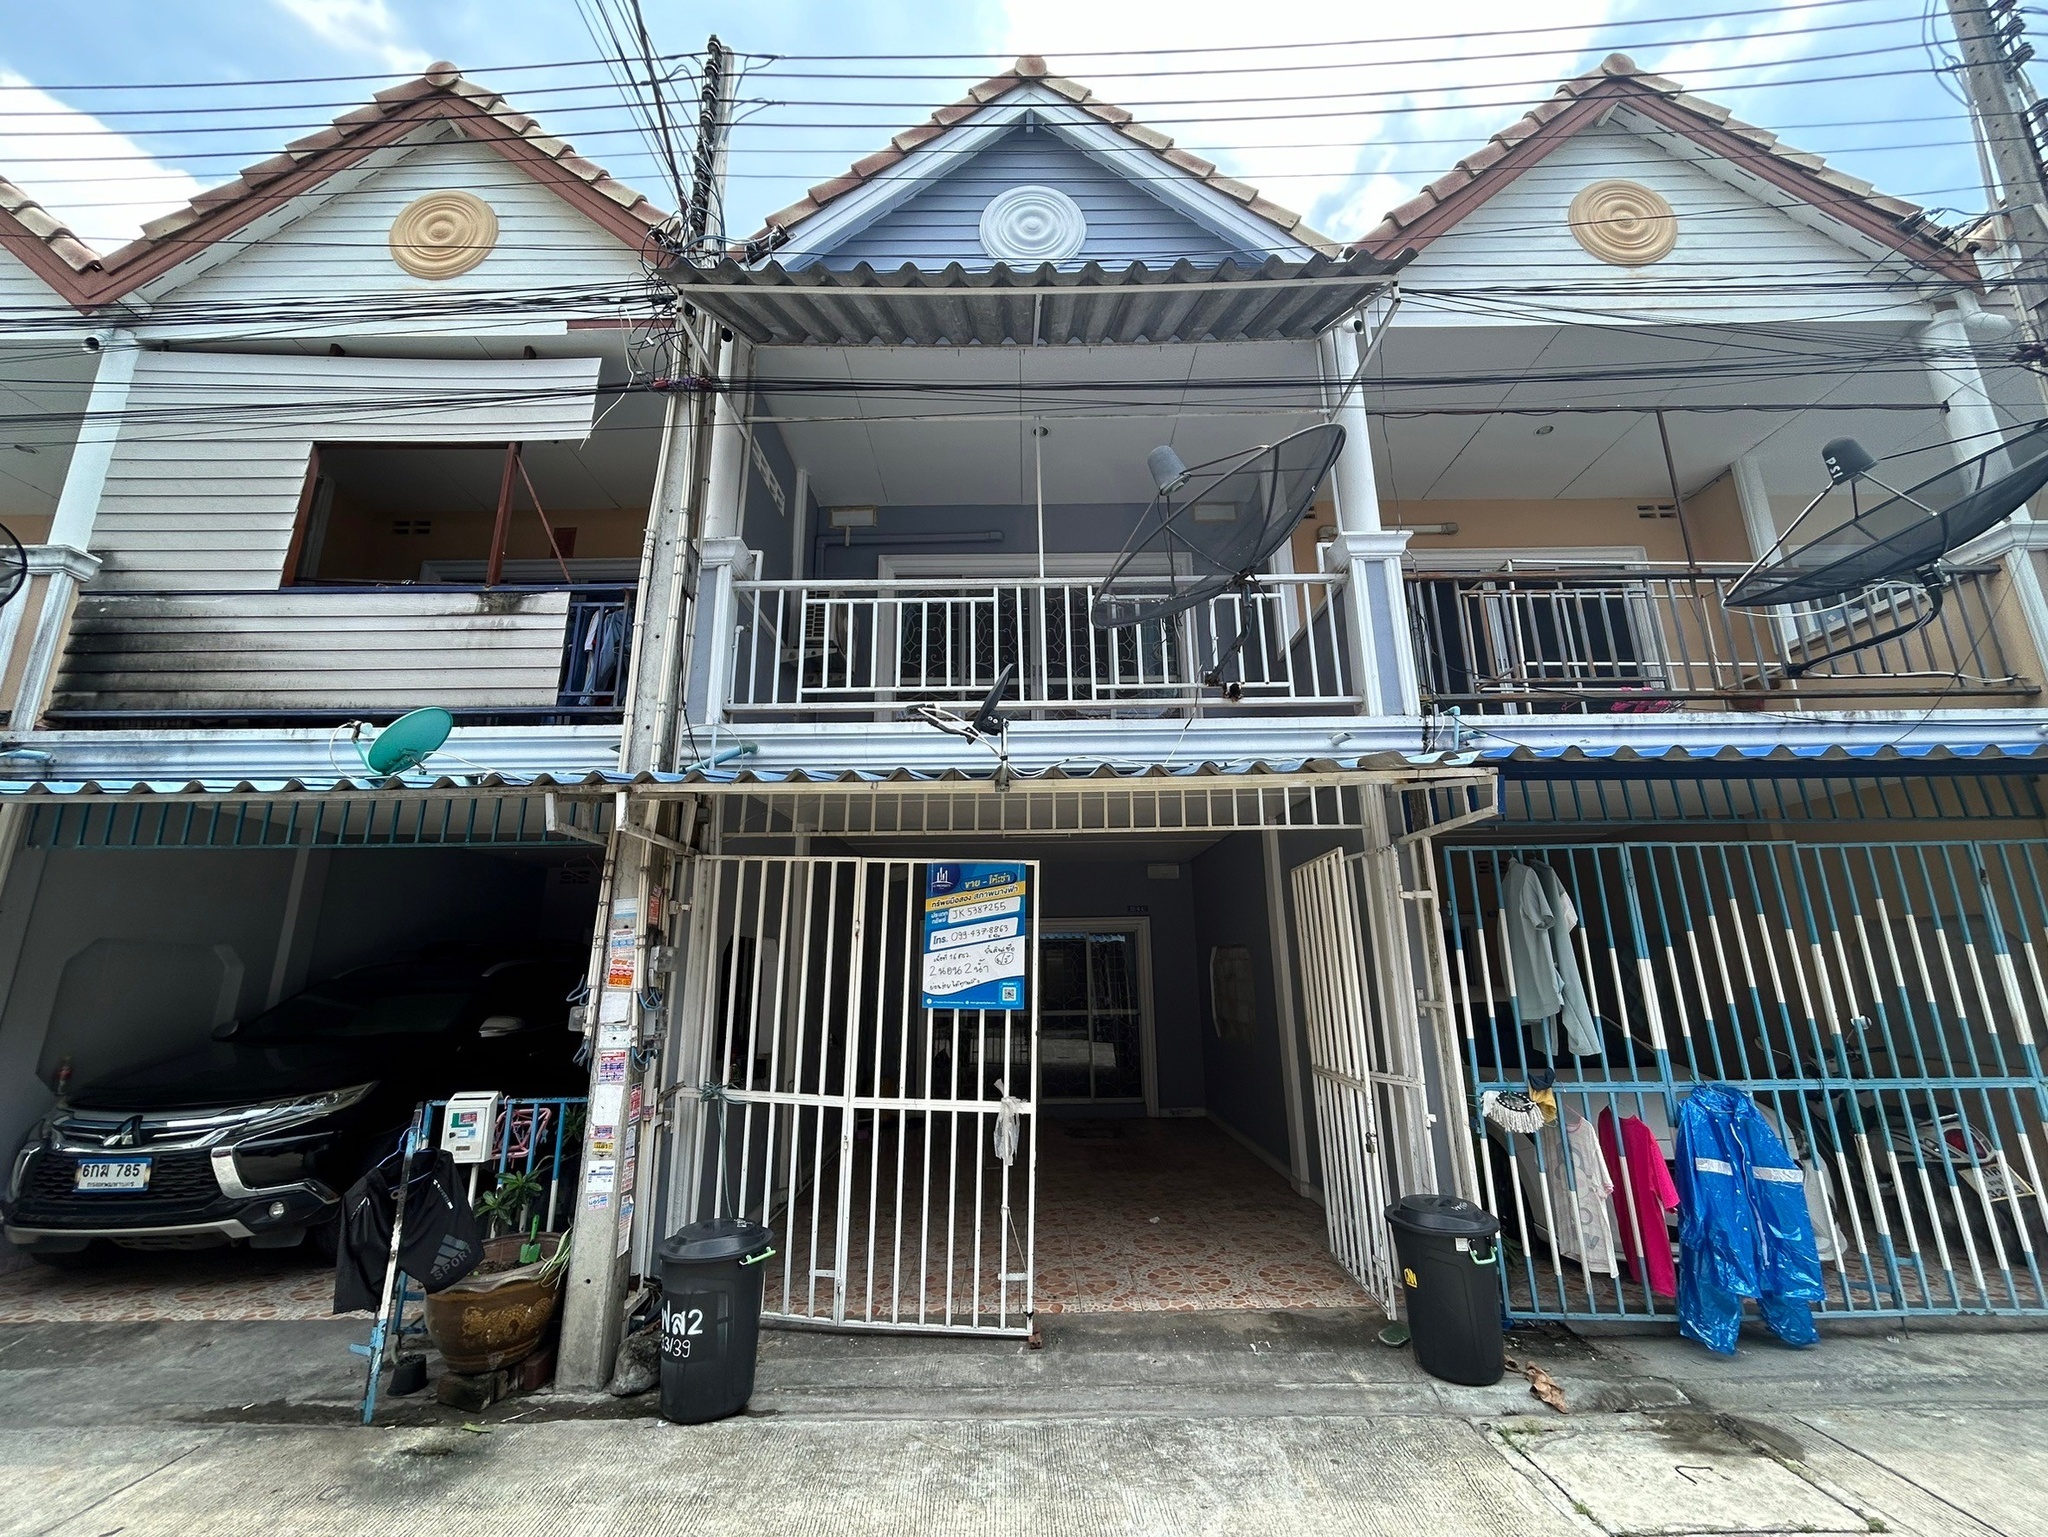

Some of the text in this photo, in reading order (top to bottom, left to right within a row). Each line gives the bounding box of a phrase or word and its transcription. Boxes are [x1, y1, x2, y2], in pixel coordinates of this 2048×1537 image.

[1825, 456, 1843, 479] PSI
[965, 880, 980, 889] ขาย
[952, 901, 1007, 920] JK 5387255
[116, 1163, 141, 1178] 785
[433, 1244, 472, 1281] SPORT
